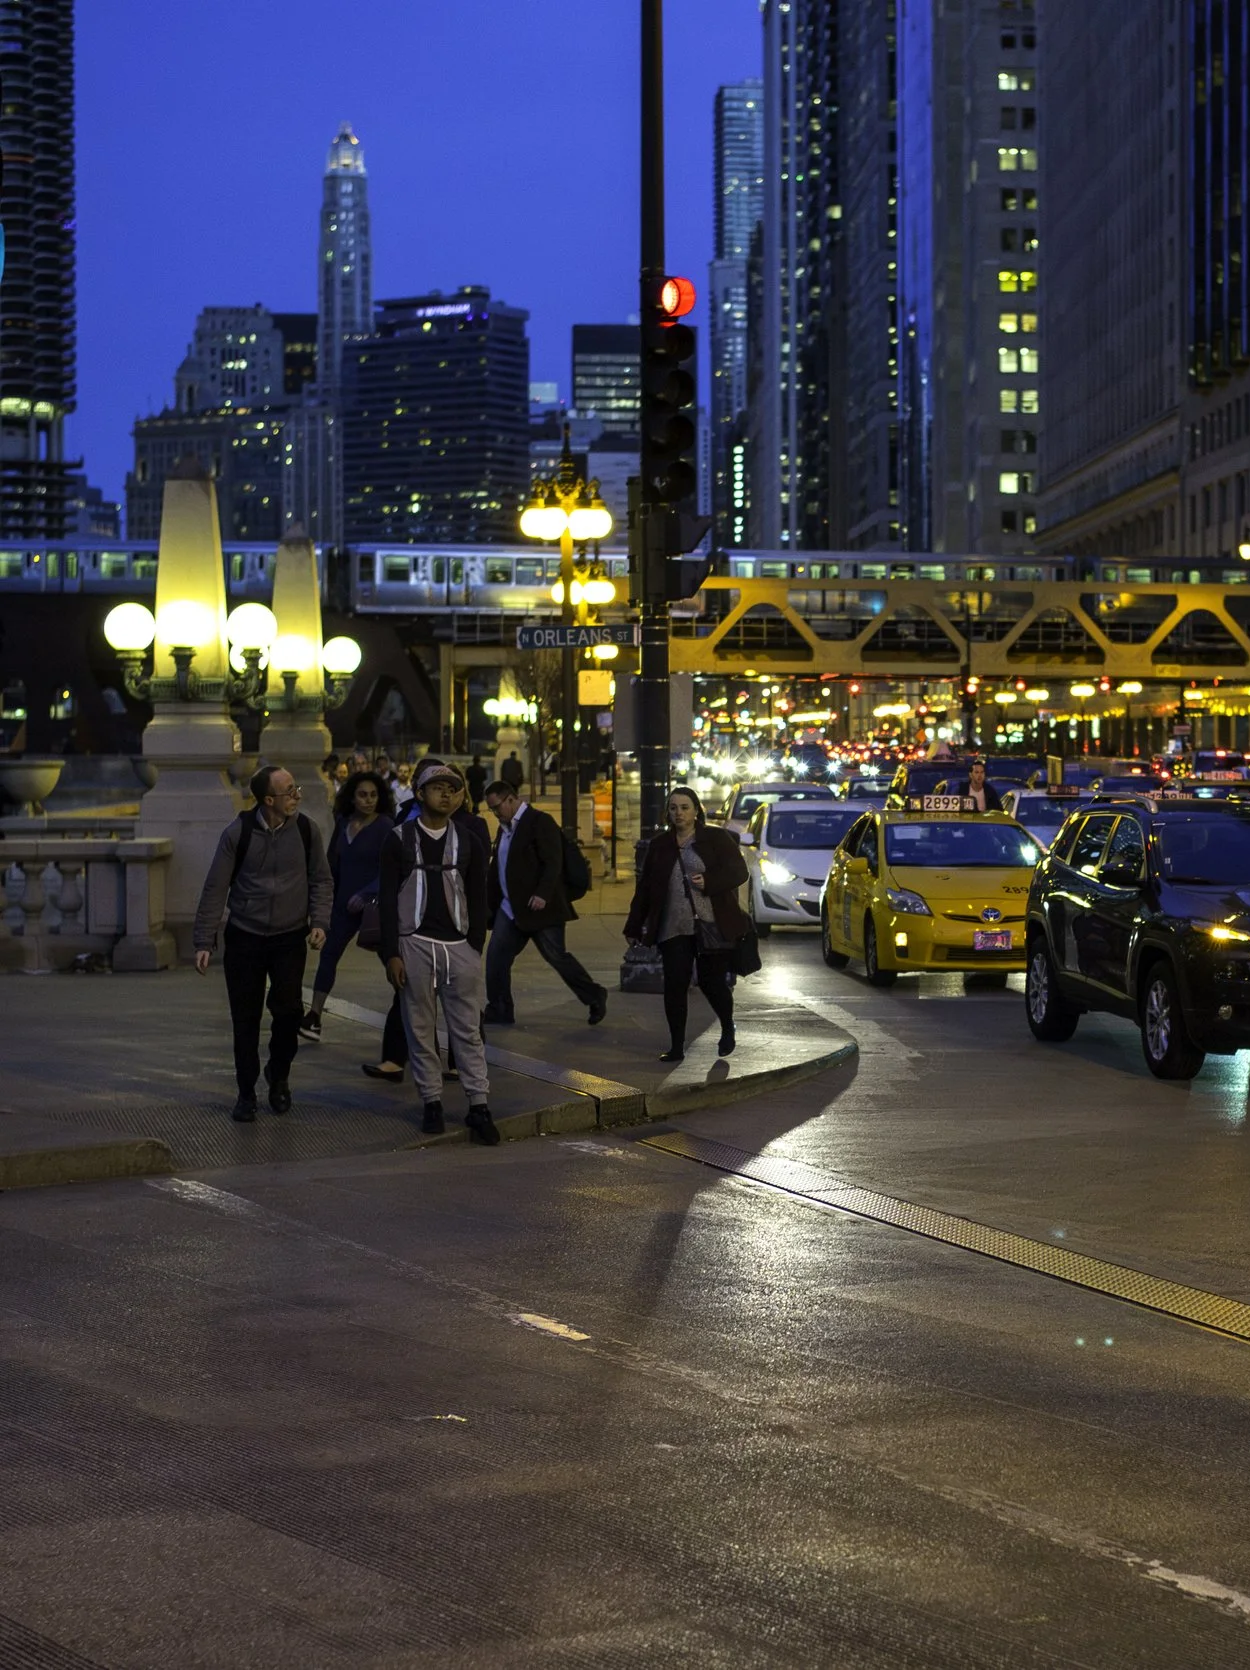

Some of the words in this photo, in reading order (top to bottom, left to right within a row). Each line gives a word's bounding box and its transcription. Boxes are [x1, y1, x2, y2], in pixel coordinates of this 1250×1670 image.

[522, 633, 529, 643] N
[533, 628, 612, 646] ORLEANS
[616, 631, 628, 641] ST
[925, 797, 959, 809] 2899
